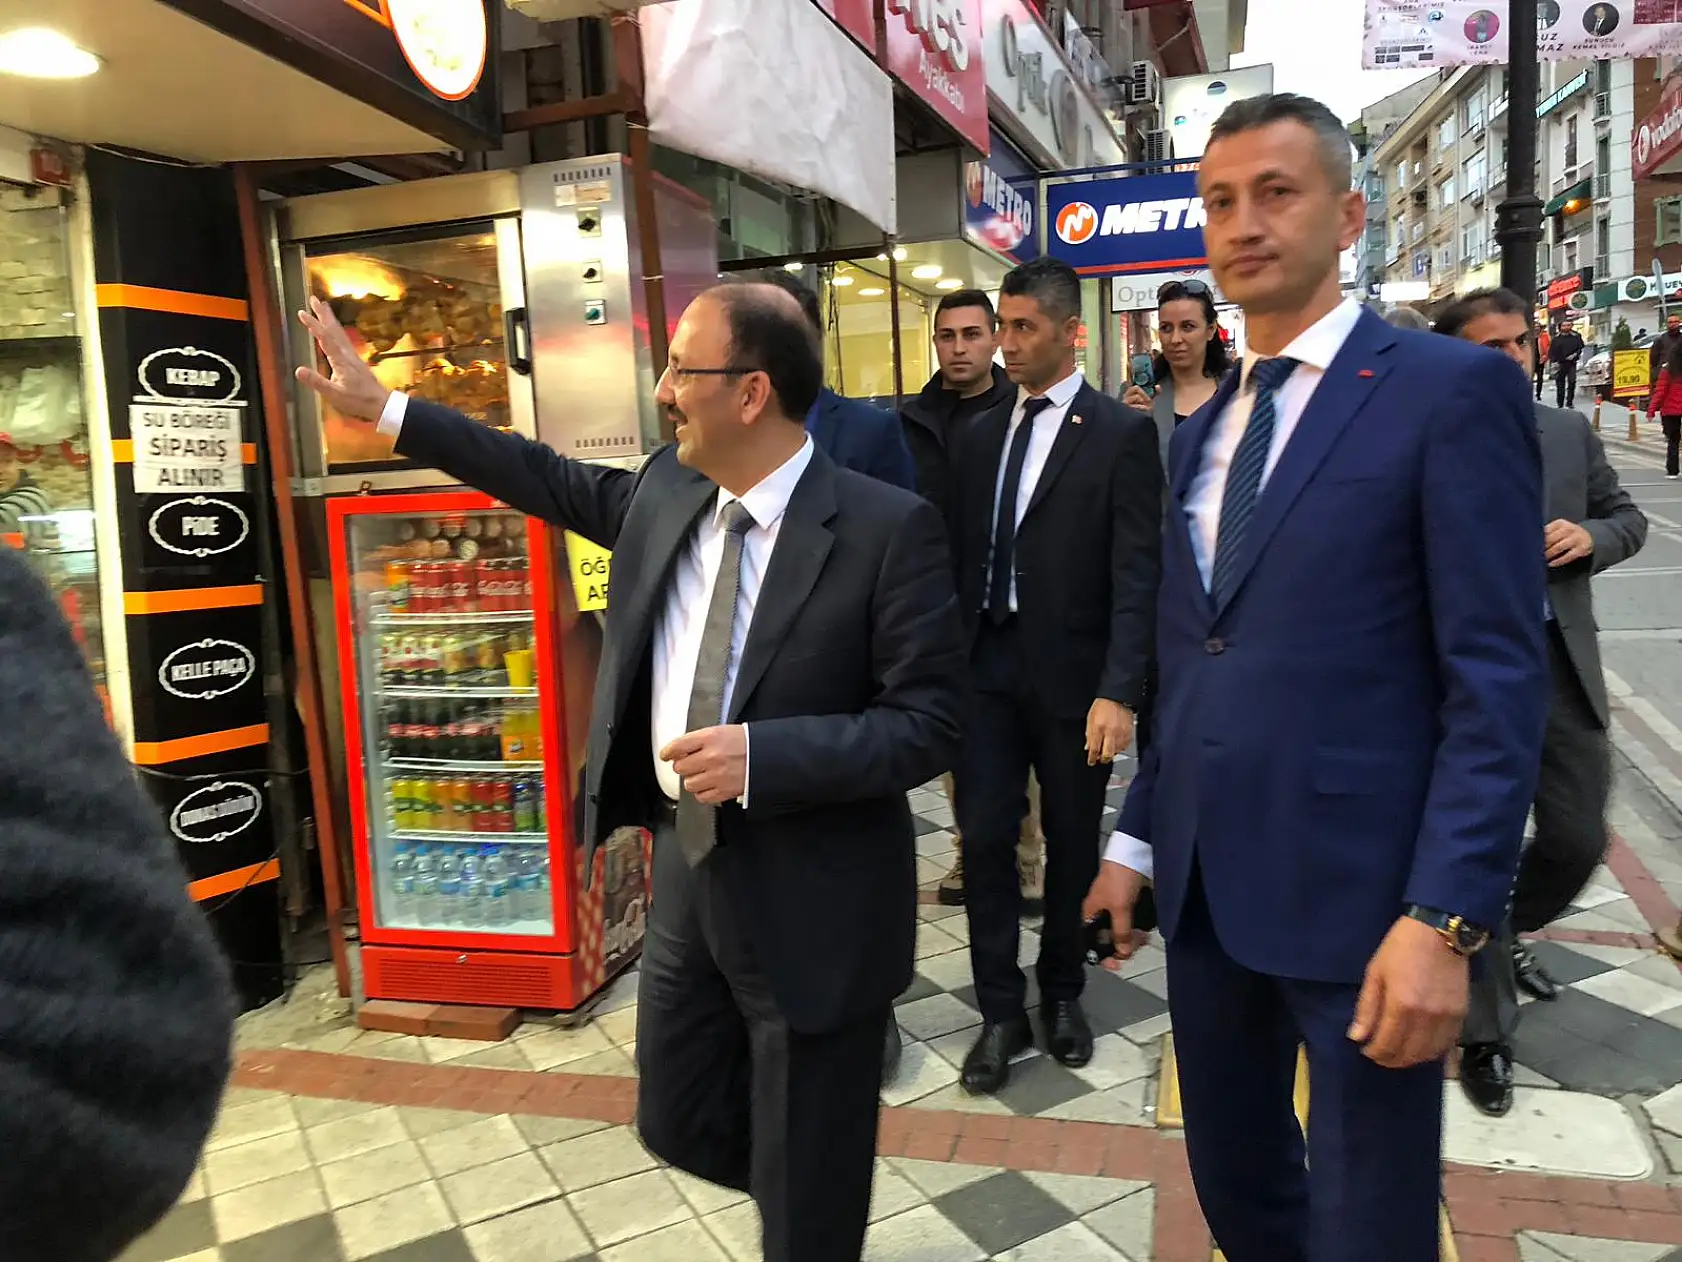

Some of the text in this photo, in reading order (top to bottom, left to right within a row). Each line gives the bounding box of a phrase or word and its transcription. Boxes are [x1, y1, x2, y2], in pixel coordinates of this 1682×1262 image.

[983, 165, 1032, 236] METRO
[1099, 197, 1207, 236] METR
[1118, 284, 1158, 307] Opt
[165, 367, 220, 387] KEBAP
[143, 410, 231, 430] SU BÖREĞİ
[151, 435, 227, 462] SİPARİŞ
[158, 467, 224, 487] ALINIR
[580, 556, 607, 576] ÖĞ
[171, 662, 213, 682] KELLE
